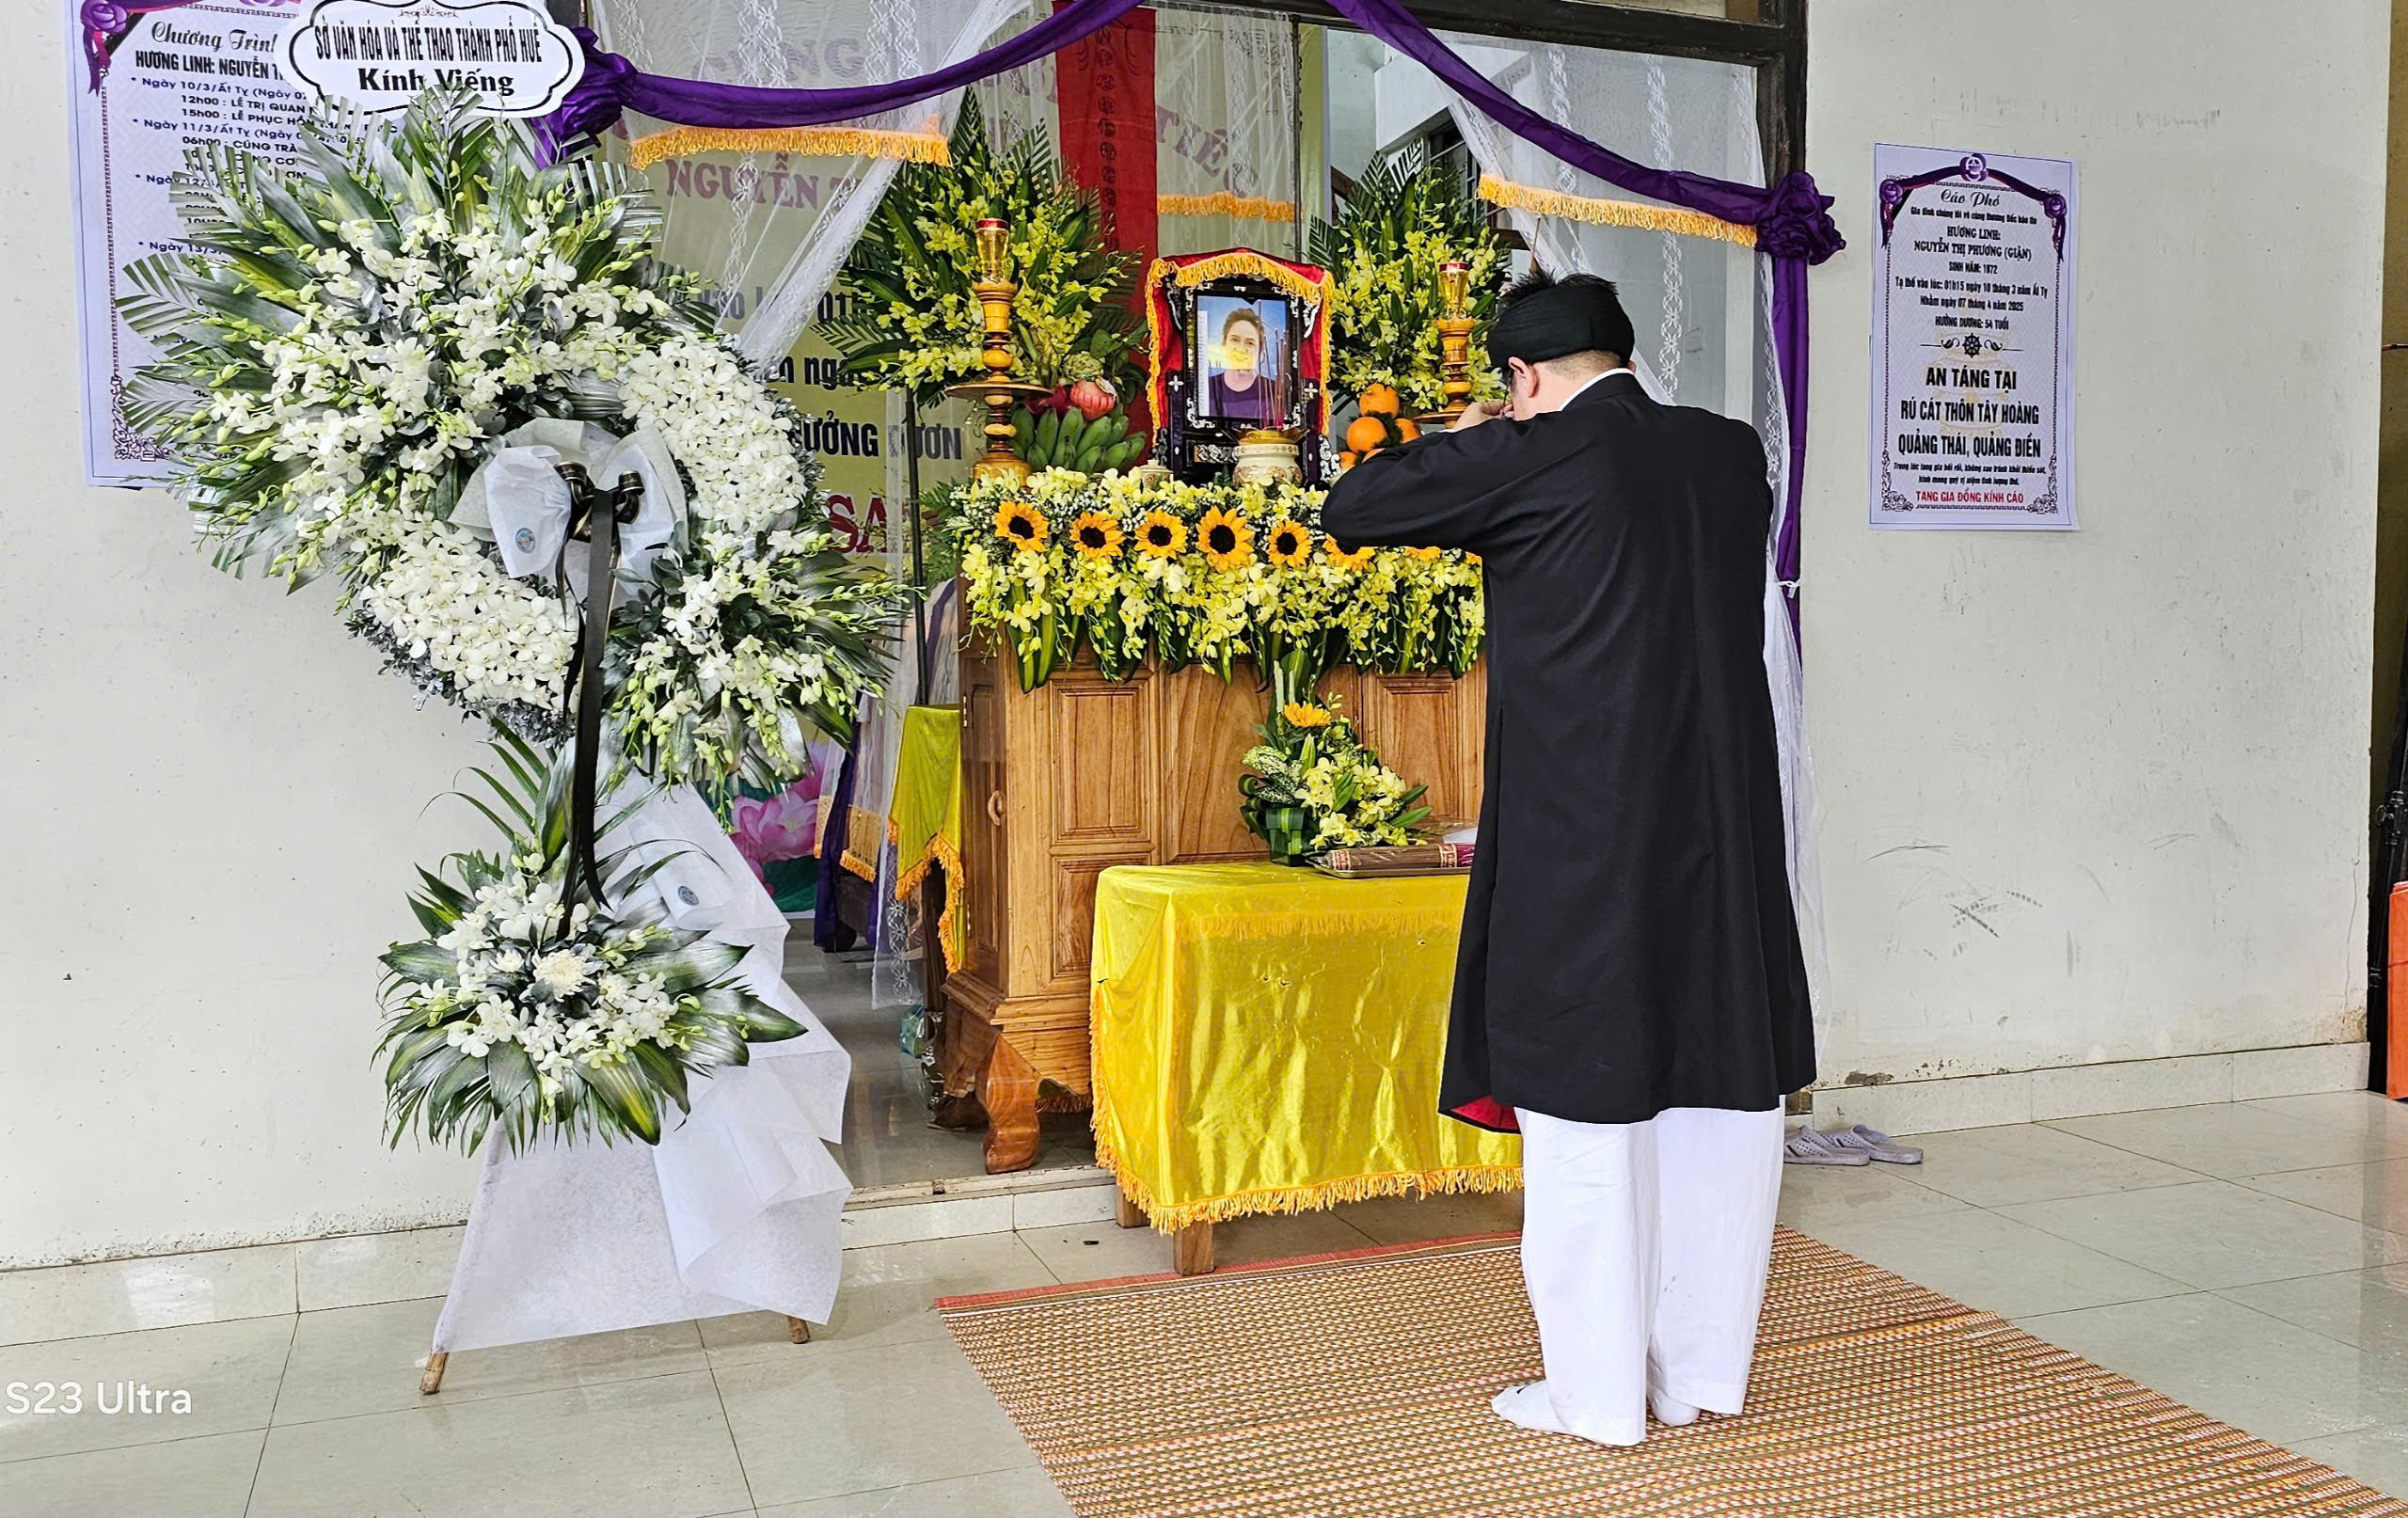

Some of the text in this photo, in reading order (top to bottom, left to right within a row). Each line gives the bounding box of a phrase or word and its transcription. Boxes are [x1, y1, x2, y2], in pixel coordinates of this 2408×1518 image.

[150, 21, 225, 52] Chương
[315, 15, 330, 60] SỞ
[333, 20, 356, 60] VĂN
[358, 20, 384, 60] HÓA
[384, 20, 401, 60] VÀ
[424, 26, 454, 61] THAO
[455, 21, 493, 62] THÀNH
[494, 15, 517, 63] PHỐ
[135, 50, 179, 71] HƯƠNG
[182, 56, 215, 74] LINH:
[218, 56, 269, 80] NGUYỄN
[142, 77, 177, 89] Ngày
[252, 88, 291, 100] (Ngày
[358, 68, 515, 97] Kính Viếng
[182, 95, 219, 105] 12h00
[269, 103, 305, 114] QUAN
[182, 108, 220, 119] 15h00
[247, 114, 283, 125] PHỤC
[144, 119, 178, 131] Ngày
[254, 128, 293, 140] (Ngày
[665, 151, 818, 210] NGUYỄN
[1941, 189, 2001, 207] Cáo Phó
[1947, 226, 2001, 240] HƯƠNG LINH:
[150, 241, 183, 253] Ngày
[1914, 237, 1949, 253] NGUYỄN
[1952, 243, 1966, 257] THỊ
[1968, 244, 2002, 258] PHƯƠNG
[1983, 264, 1998, 274] 1972
[1944, 279, 1965, 291] 01h15
[1983, 283, 1991, 293] 10
[2011, 285, 2016, 294] 3
[1957, 297, 1966, 308] 07
[1987, 299, 1991, 309] 4
[1985, 319, 1993, 329] 54
[1925, 365, 2018, 393] AN TÁNG TẠI
[1900, 395, 2039, 425] RÚ CÁT THÔN TÂY HOÀNG
[796, 410, 879, 458] ƯỞNG
[1898, 428, 1938, 455] QUẢNG
[1941, 434, 1970, 458] THÁI,
[1974, 431, 2012, 457] QUẢNG
[1916, 491, 1938, 502] TANG
[1941, 492, 1955, 502] GIA
[1984, 489, 2004, 503] KÍNH
[2007, 491, 2023, 503] CÁO
